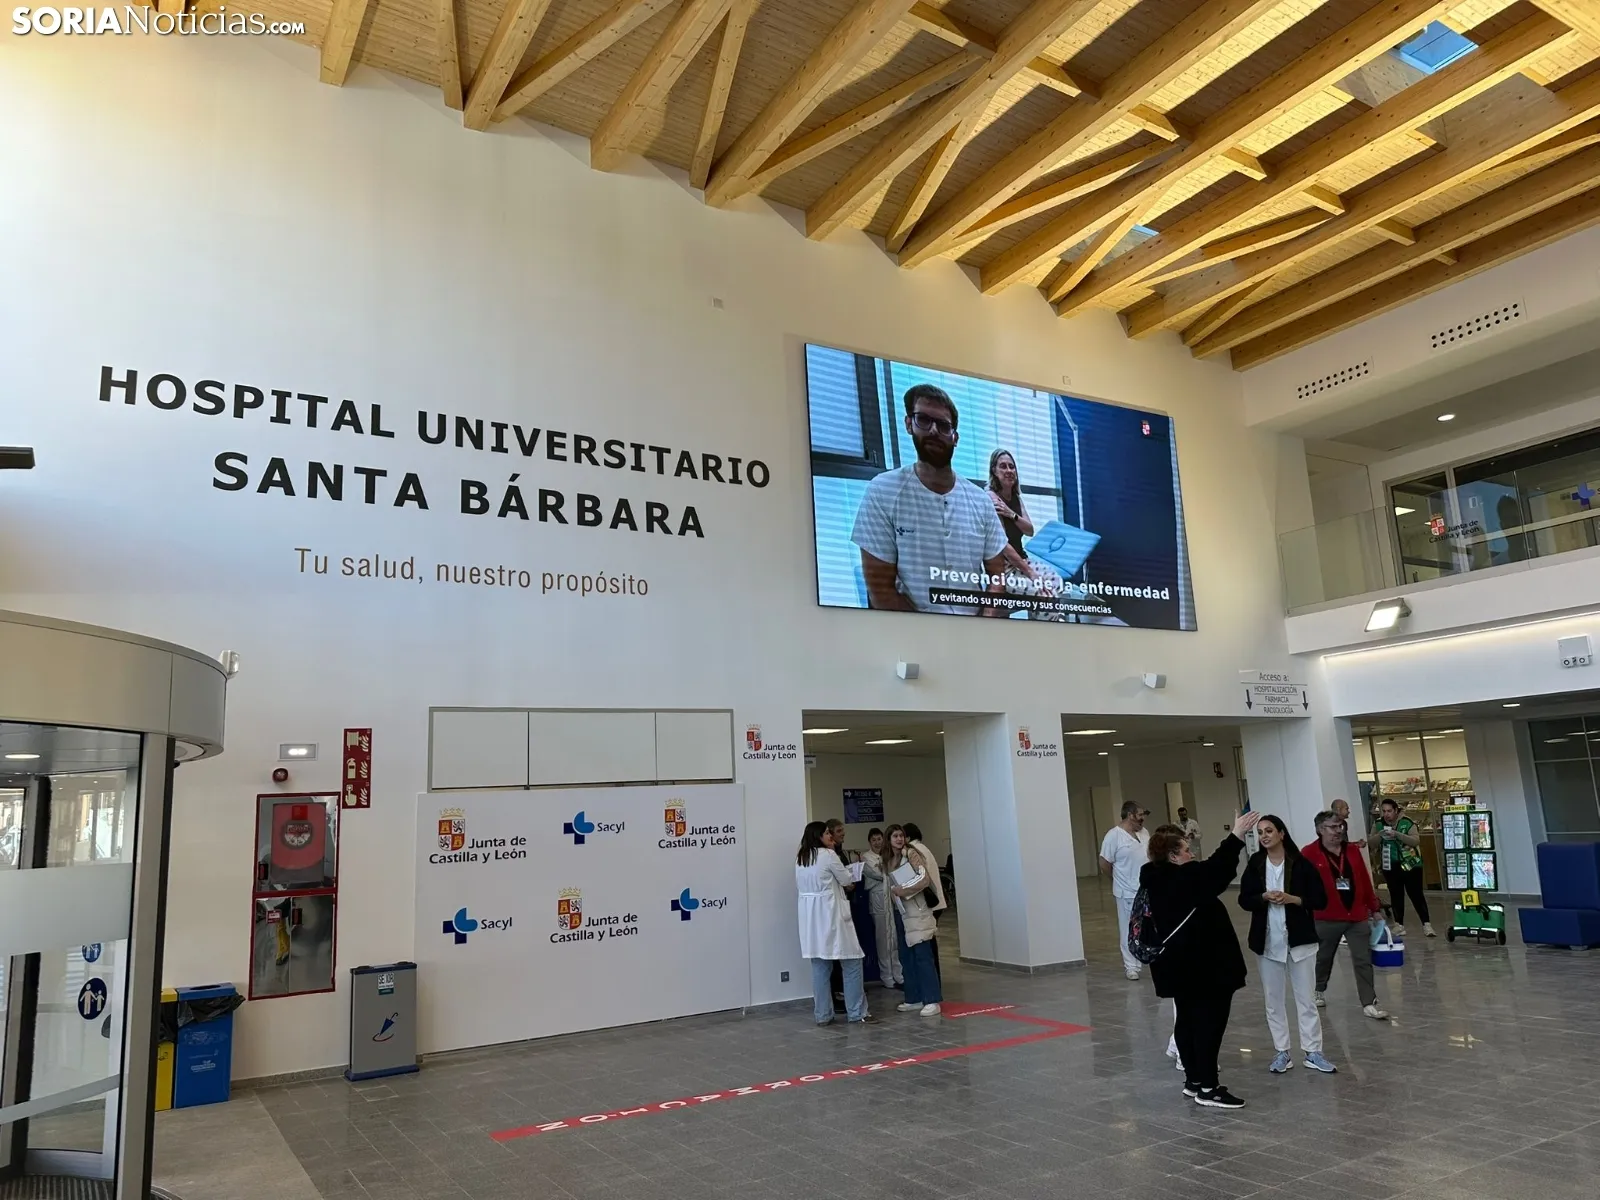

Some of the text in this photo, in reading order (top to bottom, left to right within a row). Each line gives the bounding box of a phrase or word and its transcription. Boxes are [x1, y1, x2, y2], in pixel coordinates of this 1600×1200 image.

[99, 365, 771, 488] HOSPITAL UNIVERSITARIO
[212, 451, 705, 538] SANTA BÁRBARA
[1447, 524, 1468, 532] Junta
[1461, 526, 1480, 536] León
[294, 547, 649, 597] Tu salud, nuestro propósito
[928, 566, 1170, 600] Prevención de la enfermedad
[931, 592, 1112, 615] y evitando su progreso y sus consecuencias
[1259, 673, 1290, 682] Acceso a:
[1254, 684, 1297, 694] HOSPITALIZACIÓN
[1264, 705, 1294, 714] RADIOLOGÍA
[763, 743, 797, 751] Junta de
[742, 751, 797, 761] Castilla y León
[597, 821, 625, 834] Sacyl
[689, 824, 736, 836] Junta de
[468, 836, 527, 849] Junta de
[658, 835, 736, 849] Castilla y León
[429, 849, 527, 864] Castilla y León
[702, 897, 727, 909] Sacyl
[480, 917, 513, 931] Sacyl
[585, 913, 638, 928] Junta de
[550, 926, 638, 944] Castilla y León
